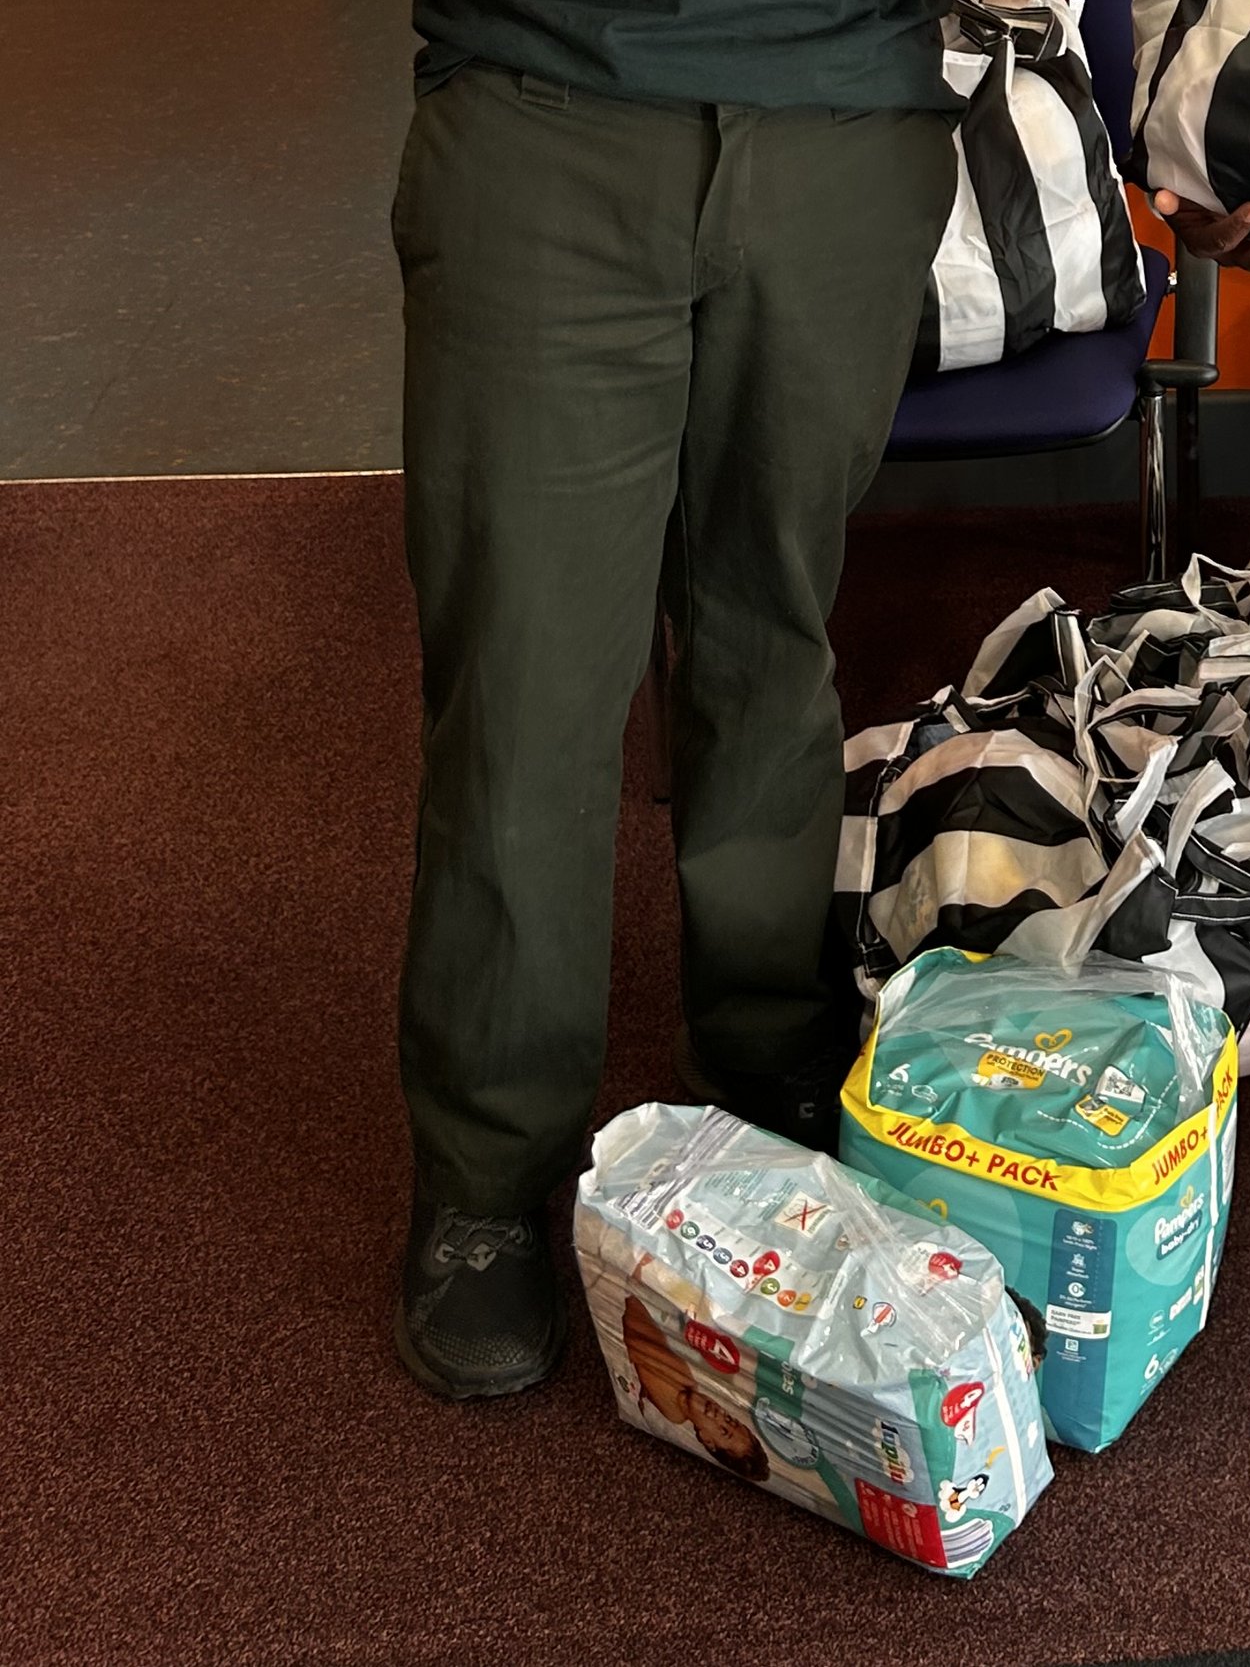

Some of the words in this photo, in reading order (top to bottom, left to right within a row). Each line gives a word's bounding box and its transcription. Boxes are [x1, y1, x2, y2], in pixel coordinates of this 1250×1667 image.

[889, 1062, 911, 1082] 6
[963, 1032, 1093, 1087] Pmpers
[986, 1054, 1047, 1077] PROTECTION
[887, 1120, 980, 1168] JUMBO+
[986, 1153, 1059, 1191] PACK
[1152, 1124, 1208, 1185] JUMBO+
[1154, 1192, 1205, 1245] Pampers
[1161, 1215, 1200, 1256] baby-dry
[709, 1338, 736, 1366] 4
[1144, 1353, 1160, 1379] 6
[959, 1387, 983, 1410] 4
[880, 1420, 905, 1486] lupilu
